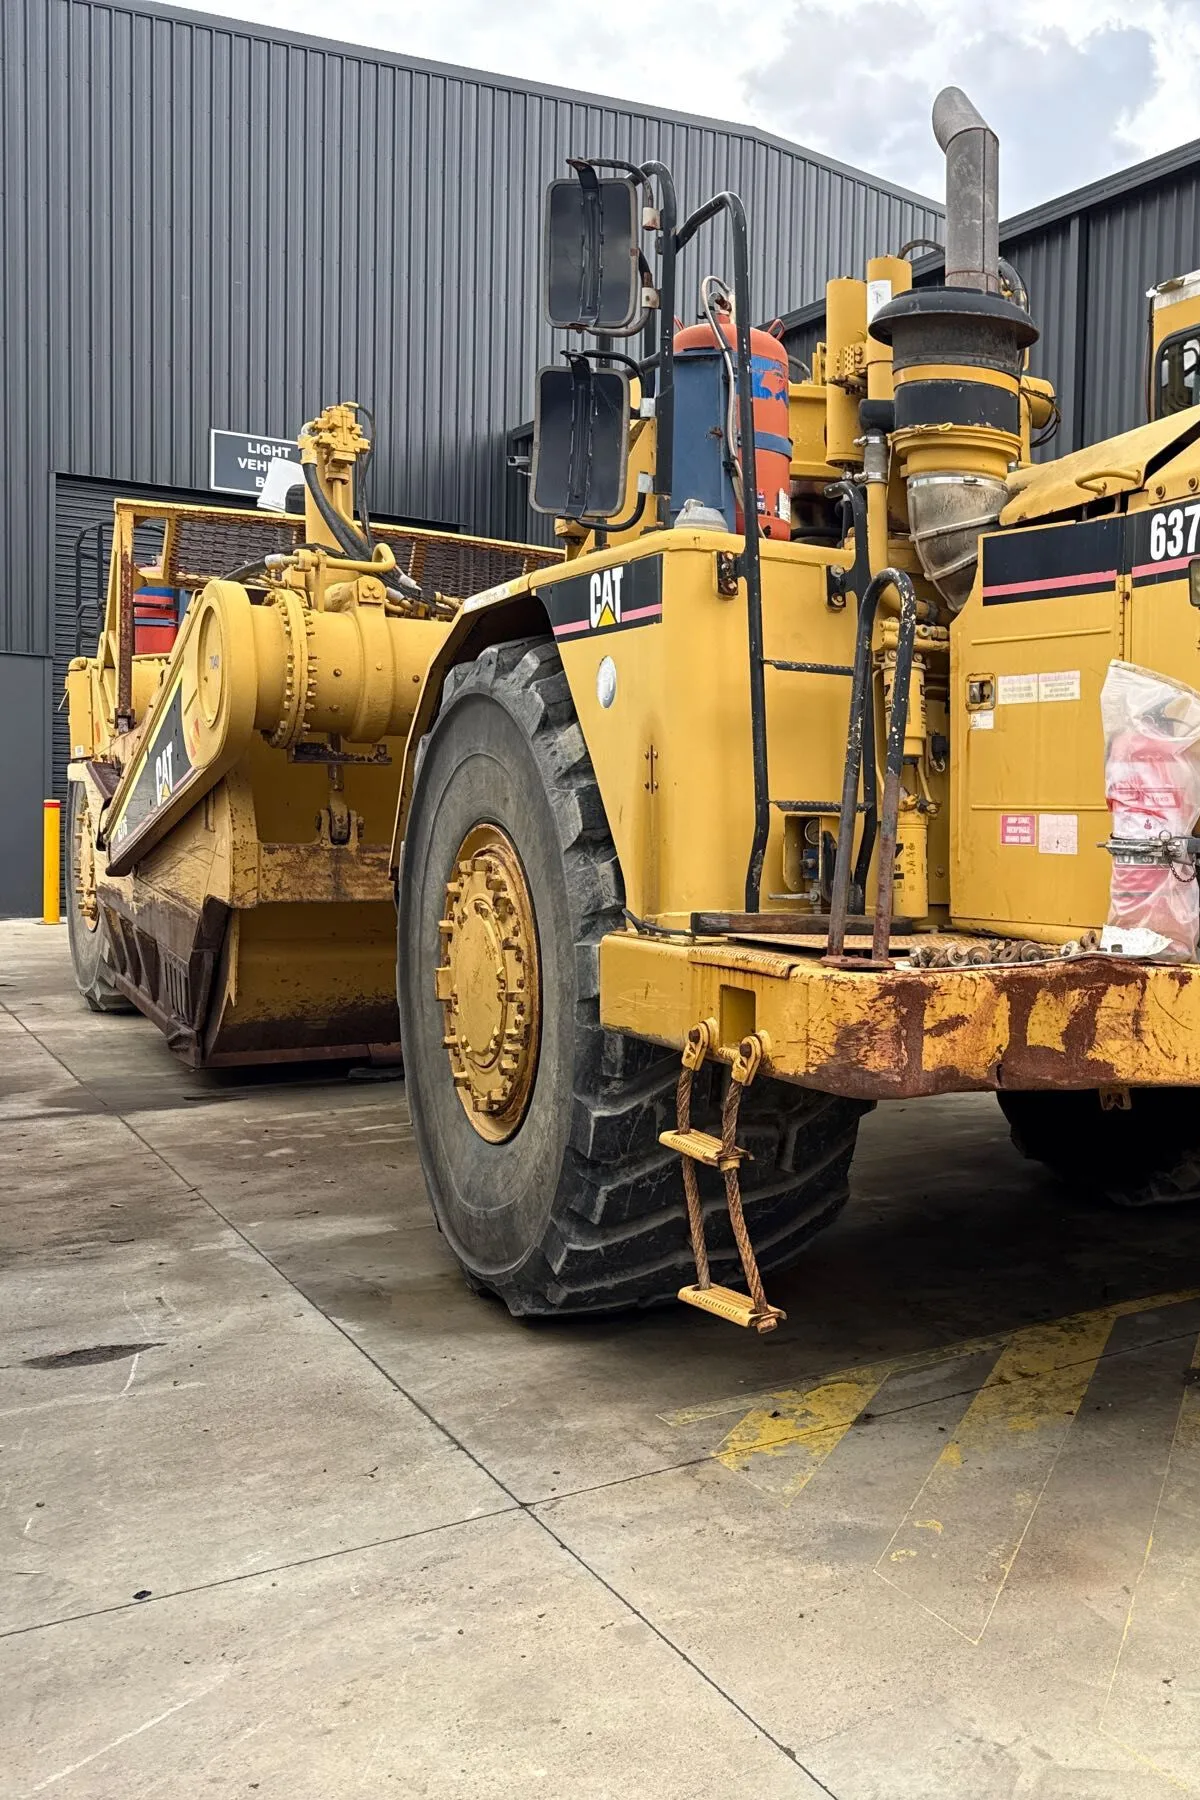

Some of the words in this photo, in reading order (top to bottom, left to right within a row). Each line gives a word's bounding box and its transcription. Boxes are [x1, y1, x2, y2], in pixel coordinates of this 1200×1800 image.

[247, 442, 291, 458] LIGHT
[589, 566, 624, 629] CAT
[155, 741, 174, 807] CAT
